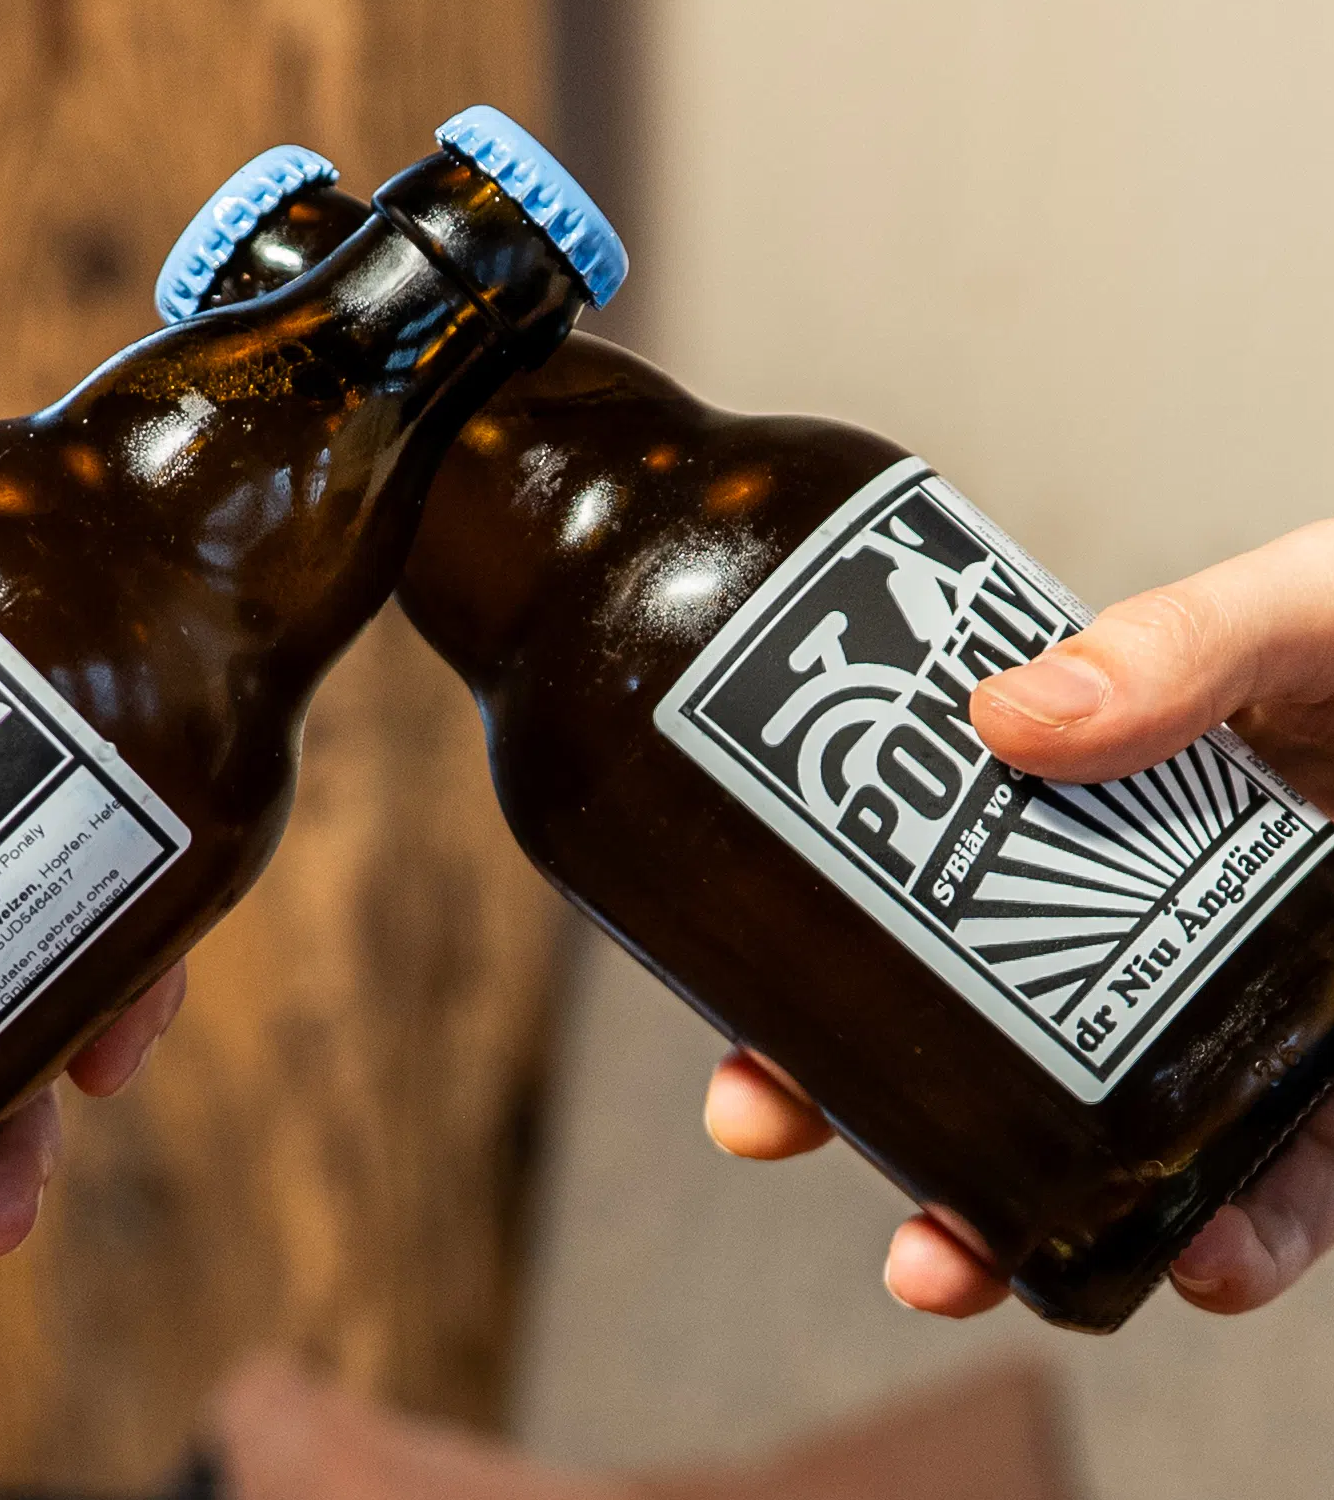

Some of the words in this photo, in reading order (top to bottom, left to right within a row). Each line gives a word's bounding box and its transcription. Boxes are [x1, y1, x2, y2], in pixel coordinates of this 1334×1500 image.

[984, 783, 1014, 819] vo
[38, 832, 92, 879] Hopfen,
[36, 900, 87, 953] gebraut
[86, 869, 120, 902] ohne
[1076, 1004, 1117, 1052] dr
[1107, 938, 1181, 1009] Niu
[1163, 810, 1301, 943] Ängländer
